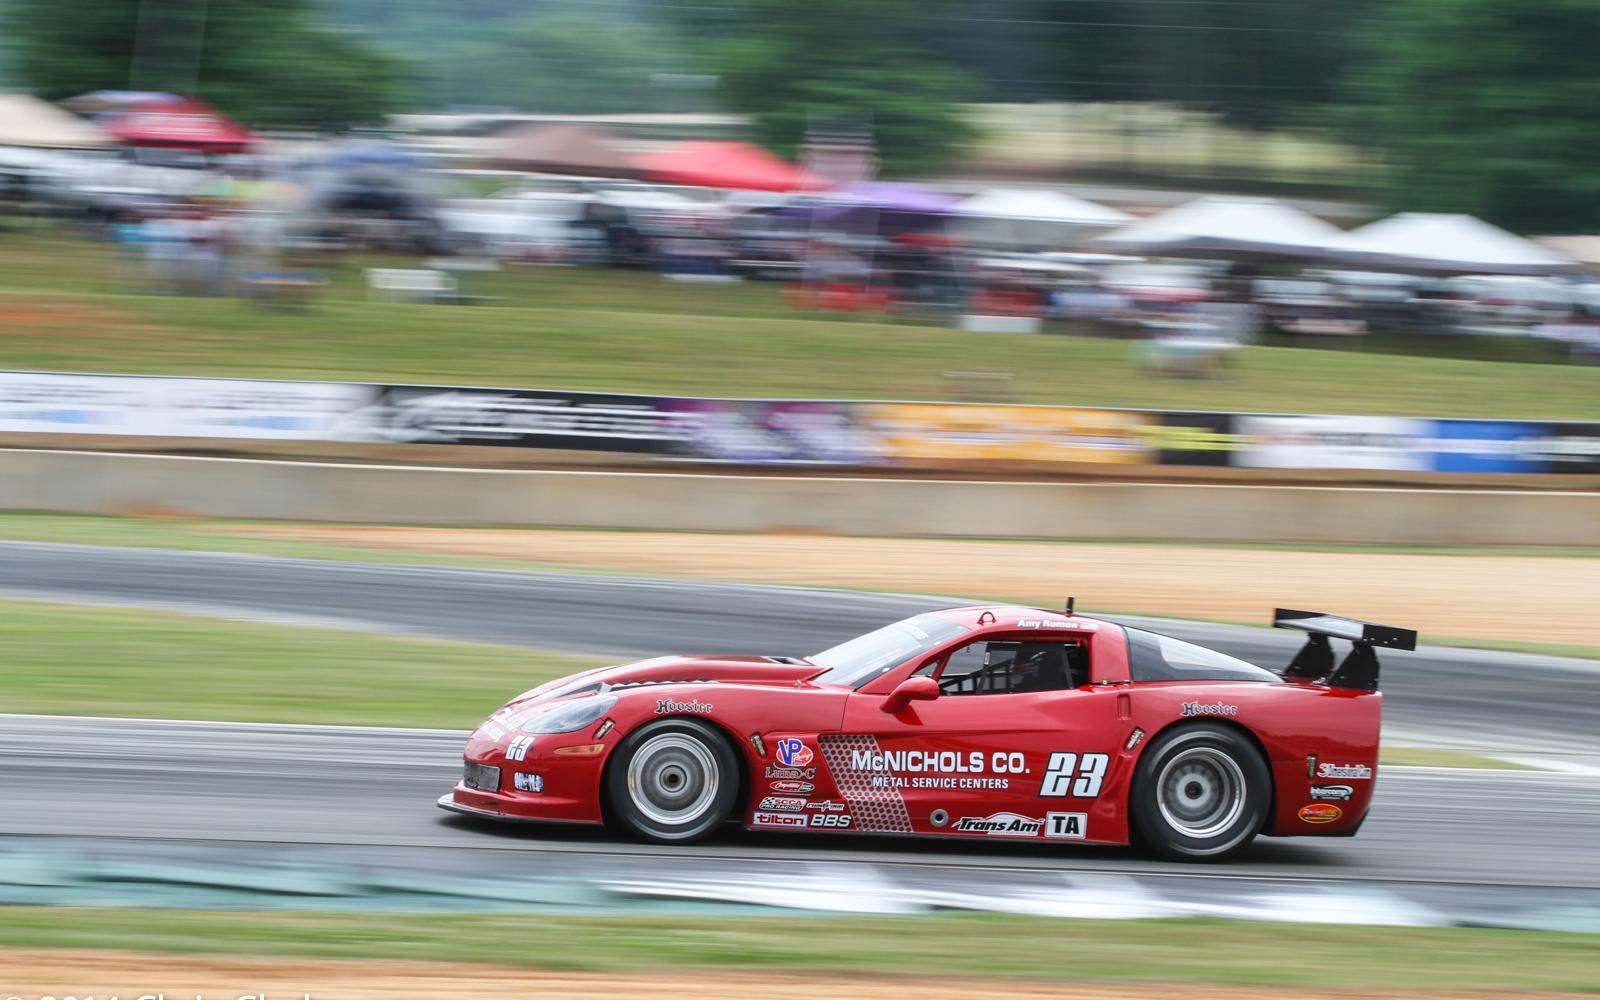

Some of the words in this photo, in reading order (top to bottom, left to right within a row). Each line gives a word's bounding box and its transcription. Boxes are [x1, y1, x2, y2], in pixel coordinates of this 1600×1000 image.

[1017, 619, 1041, 629] Amy
[655, 699, 713, 714] Hoosier
[1180, 701, 1238, 716] Hoosier
[778, 738, 803, 766] VP
[851, 750, 984, 773] McNICHOLS
[992, 752, 1031, 774] CO.
[1039, 751, 1109, 798] 23
[872, 777, 909, 788] METAL
[912, 777, 956, 789] SERVICE
[959, 778, 1009, 789] CENTERS
[757, 815, 804, 825] tilton
[810, 814, 852, 827] BBS
[960, 818, 1007, 831] Trans
[1007, 819, 1039, 832] Am
[1052, 815, 1080, 835] TA
